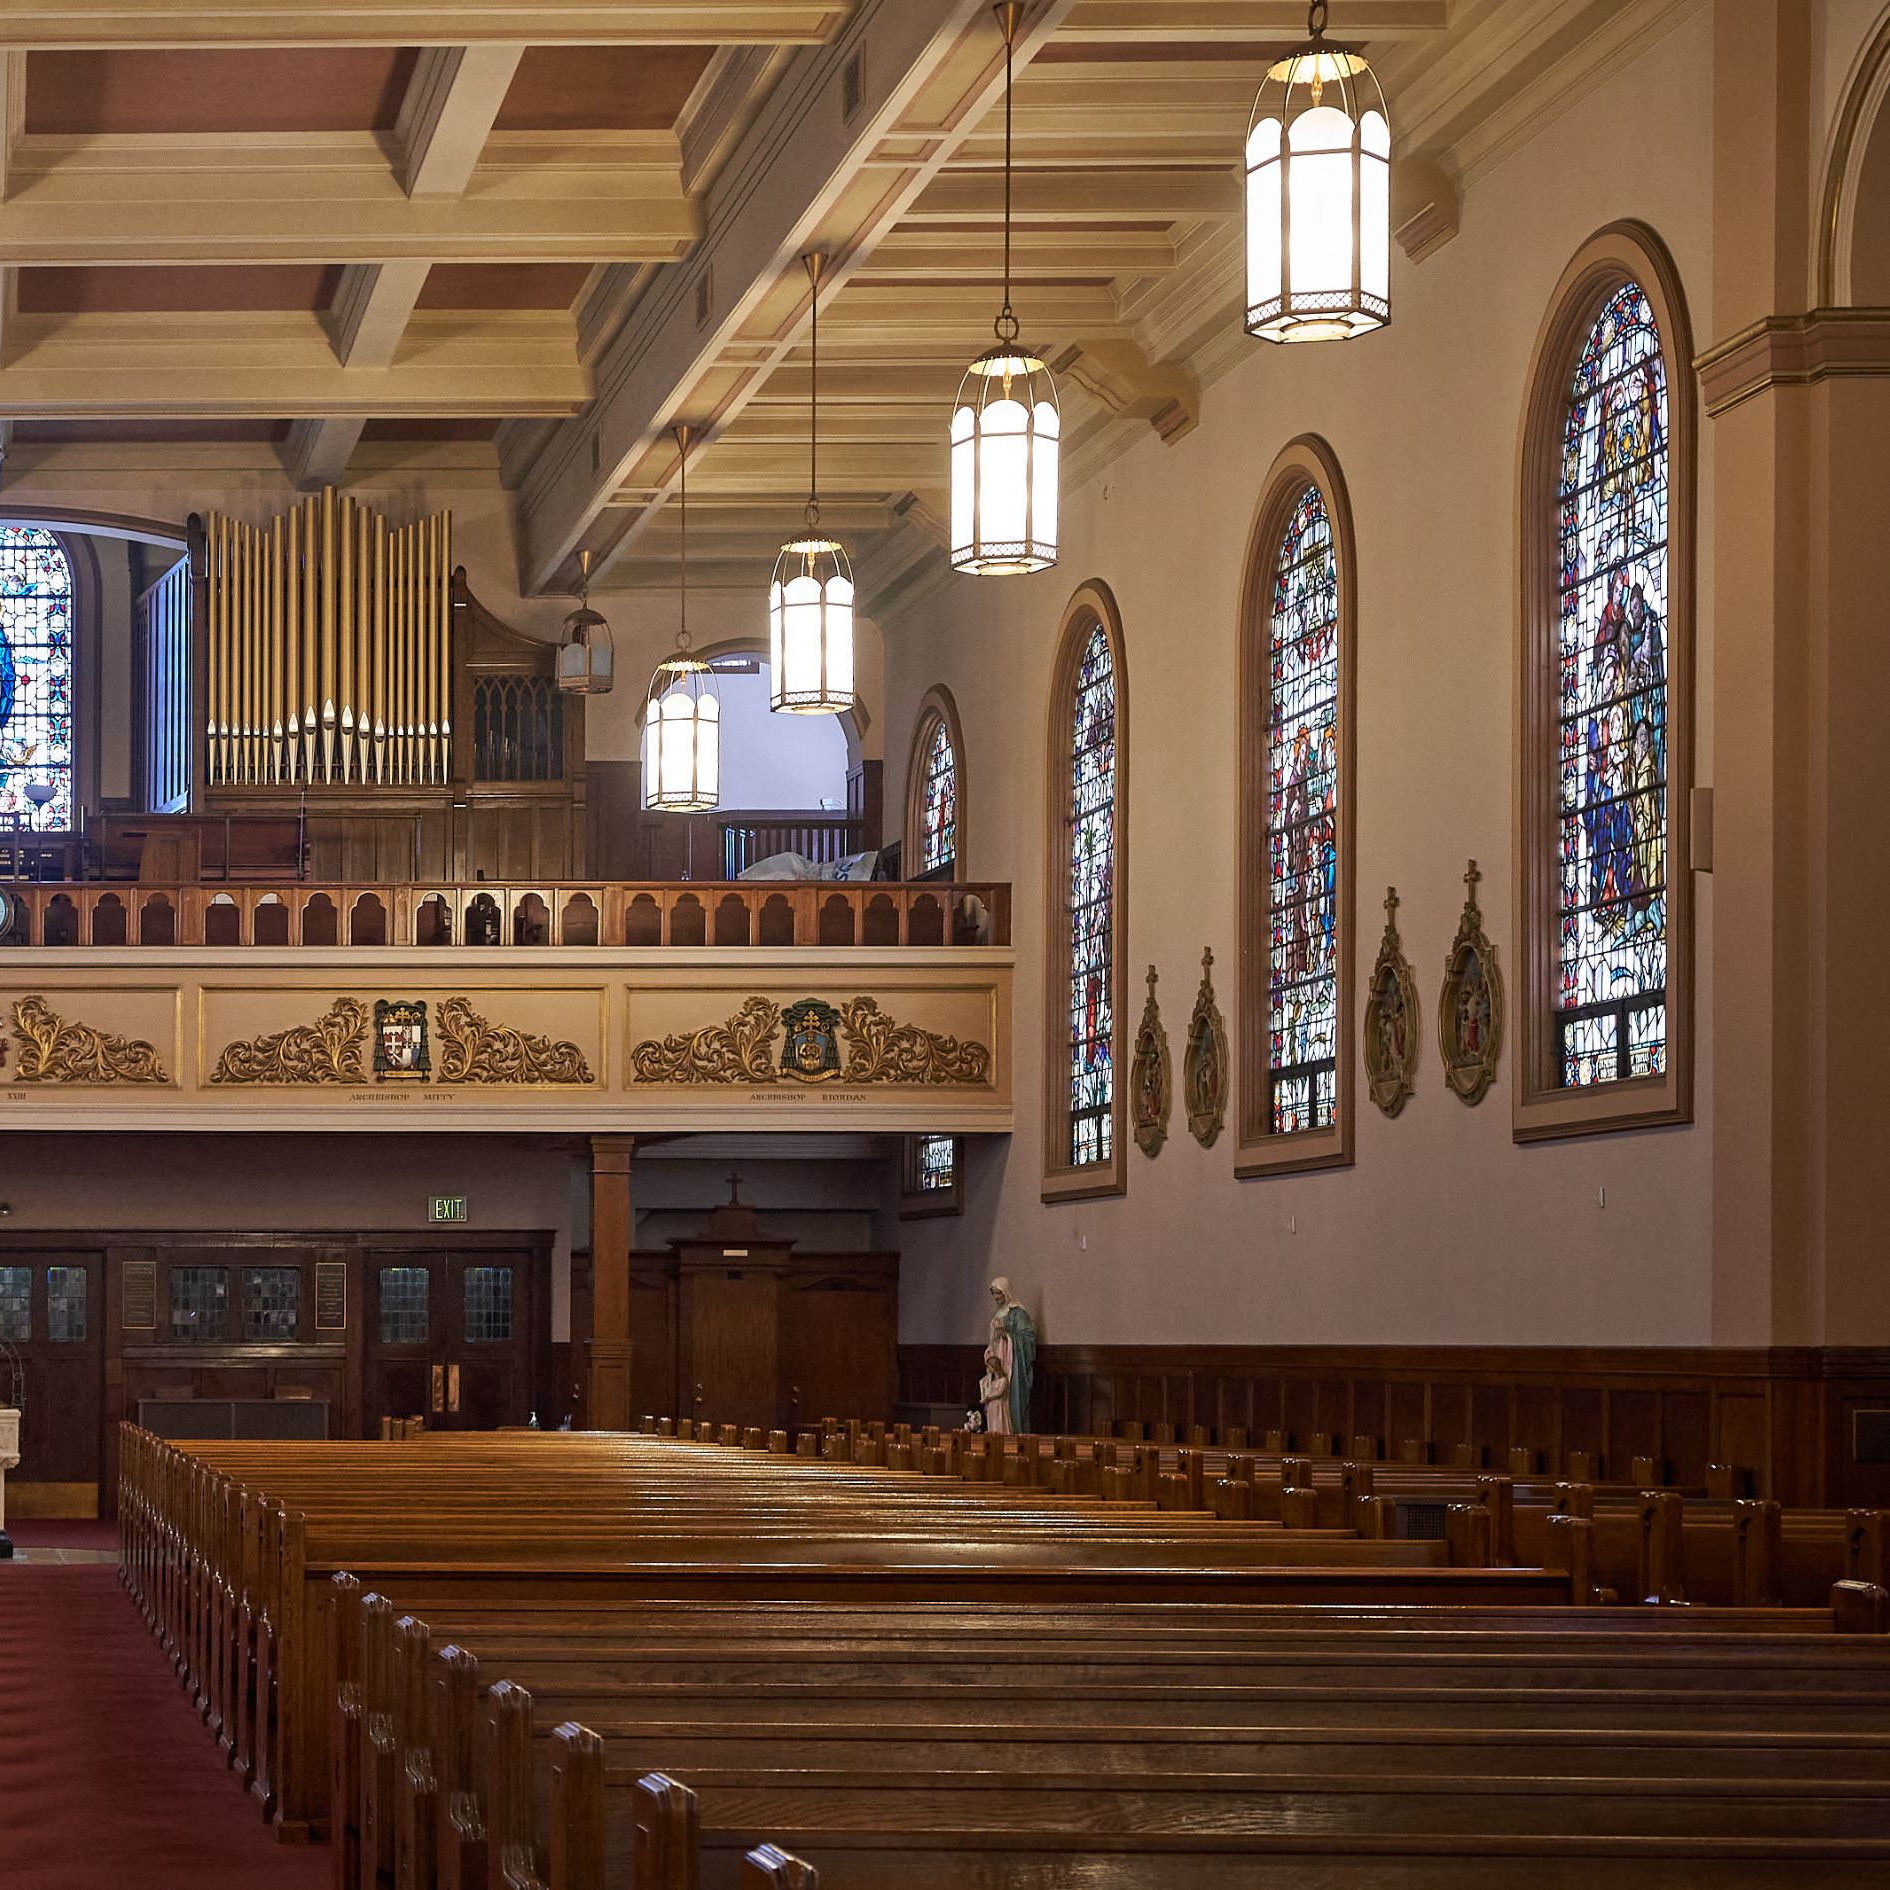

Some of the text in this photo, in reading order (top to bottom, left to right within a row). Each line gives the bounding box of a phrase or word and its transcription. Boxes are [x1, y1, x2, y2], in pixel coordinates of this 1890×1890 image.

[350, 1093, 455, 1101] ARCHBISHOP MITTY
[750, 1093, 867, 1101] ARCHBISHOP RIORDAN
